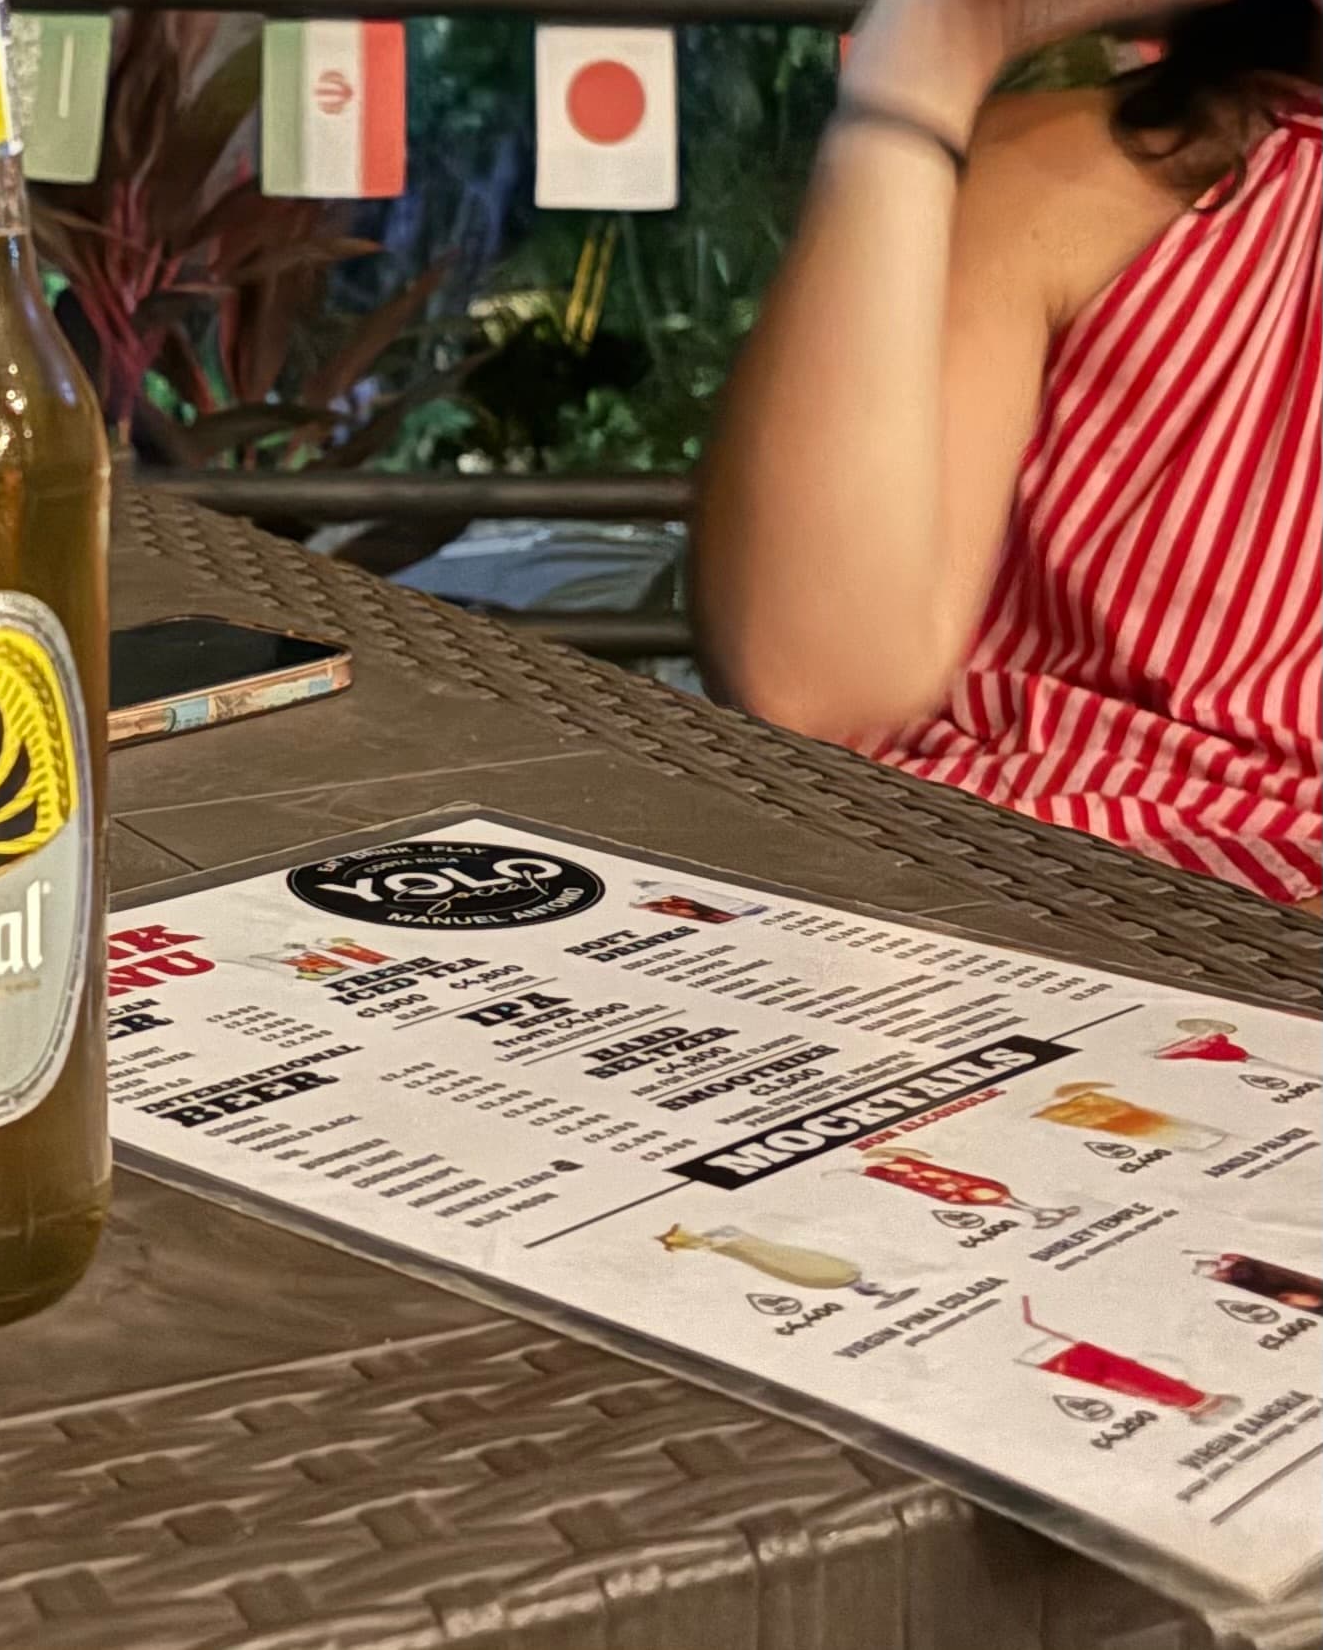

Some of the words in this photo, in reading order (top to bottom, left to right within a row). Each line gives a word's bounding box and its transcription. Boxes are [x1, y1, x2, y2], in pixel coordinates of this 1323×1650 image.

[315, 858, 563, 903] YOLO
[386, 911, 509, 927] MANUEL
[564, 930, 639, 955] SOFT
[587, 926, 699, 962] DRINKS
[323, 957, 441, 992] FRESH
[329, 978, 419, 1005] ICED
[414, 958, 489, 978] TEA
[456, 992, 571, 1027] IPA
[510, 1007, 579, 1029] BEER
[492, 1029, 556, 1048] from
[582, 1027, 688, 1062] HARD
[584, 1027, 739, 1079] SELTZER
[135, 1045, 363, 1114] INTERNATIONAL
[657, 1045, 840, 1111] SMOOTHIES
[157, 1071, 339, 1128] BEER
[705, 1047, 1038, 1177] MOCKTAILS
[1084, 1202, 1154, 1232] TEMPLE
